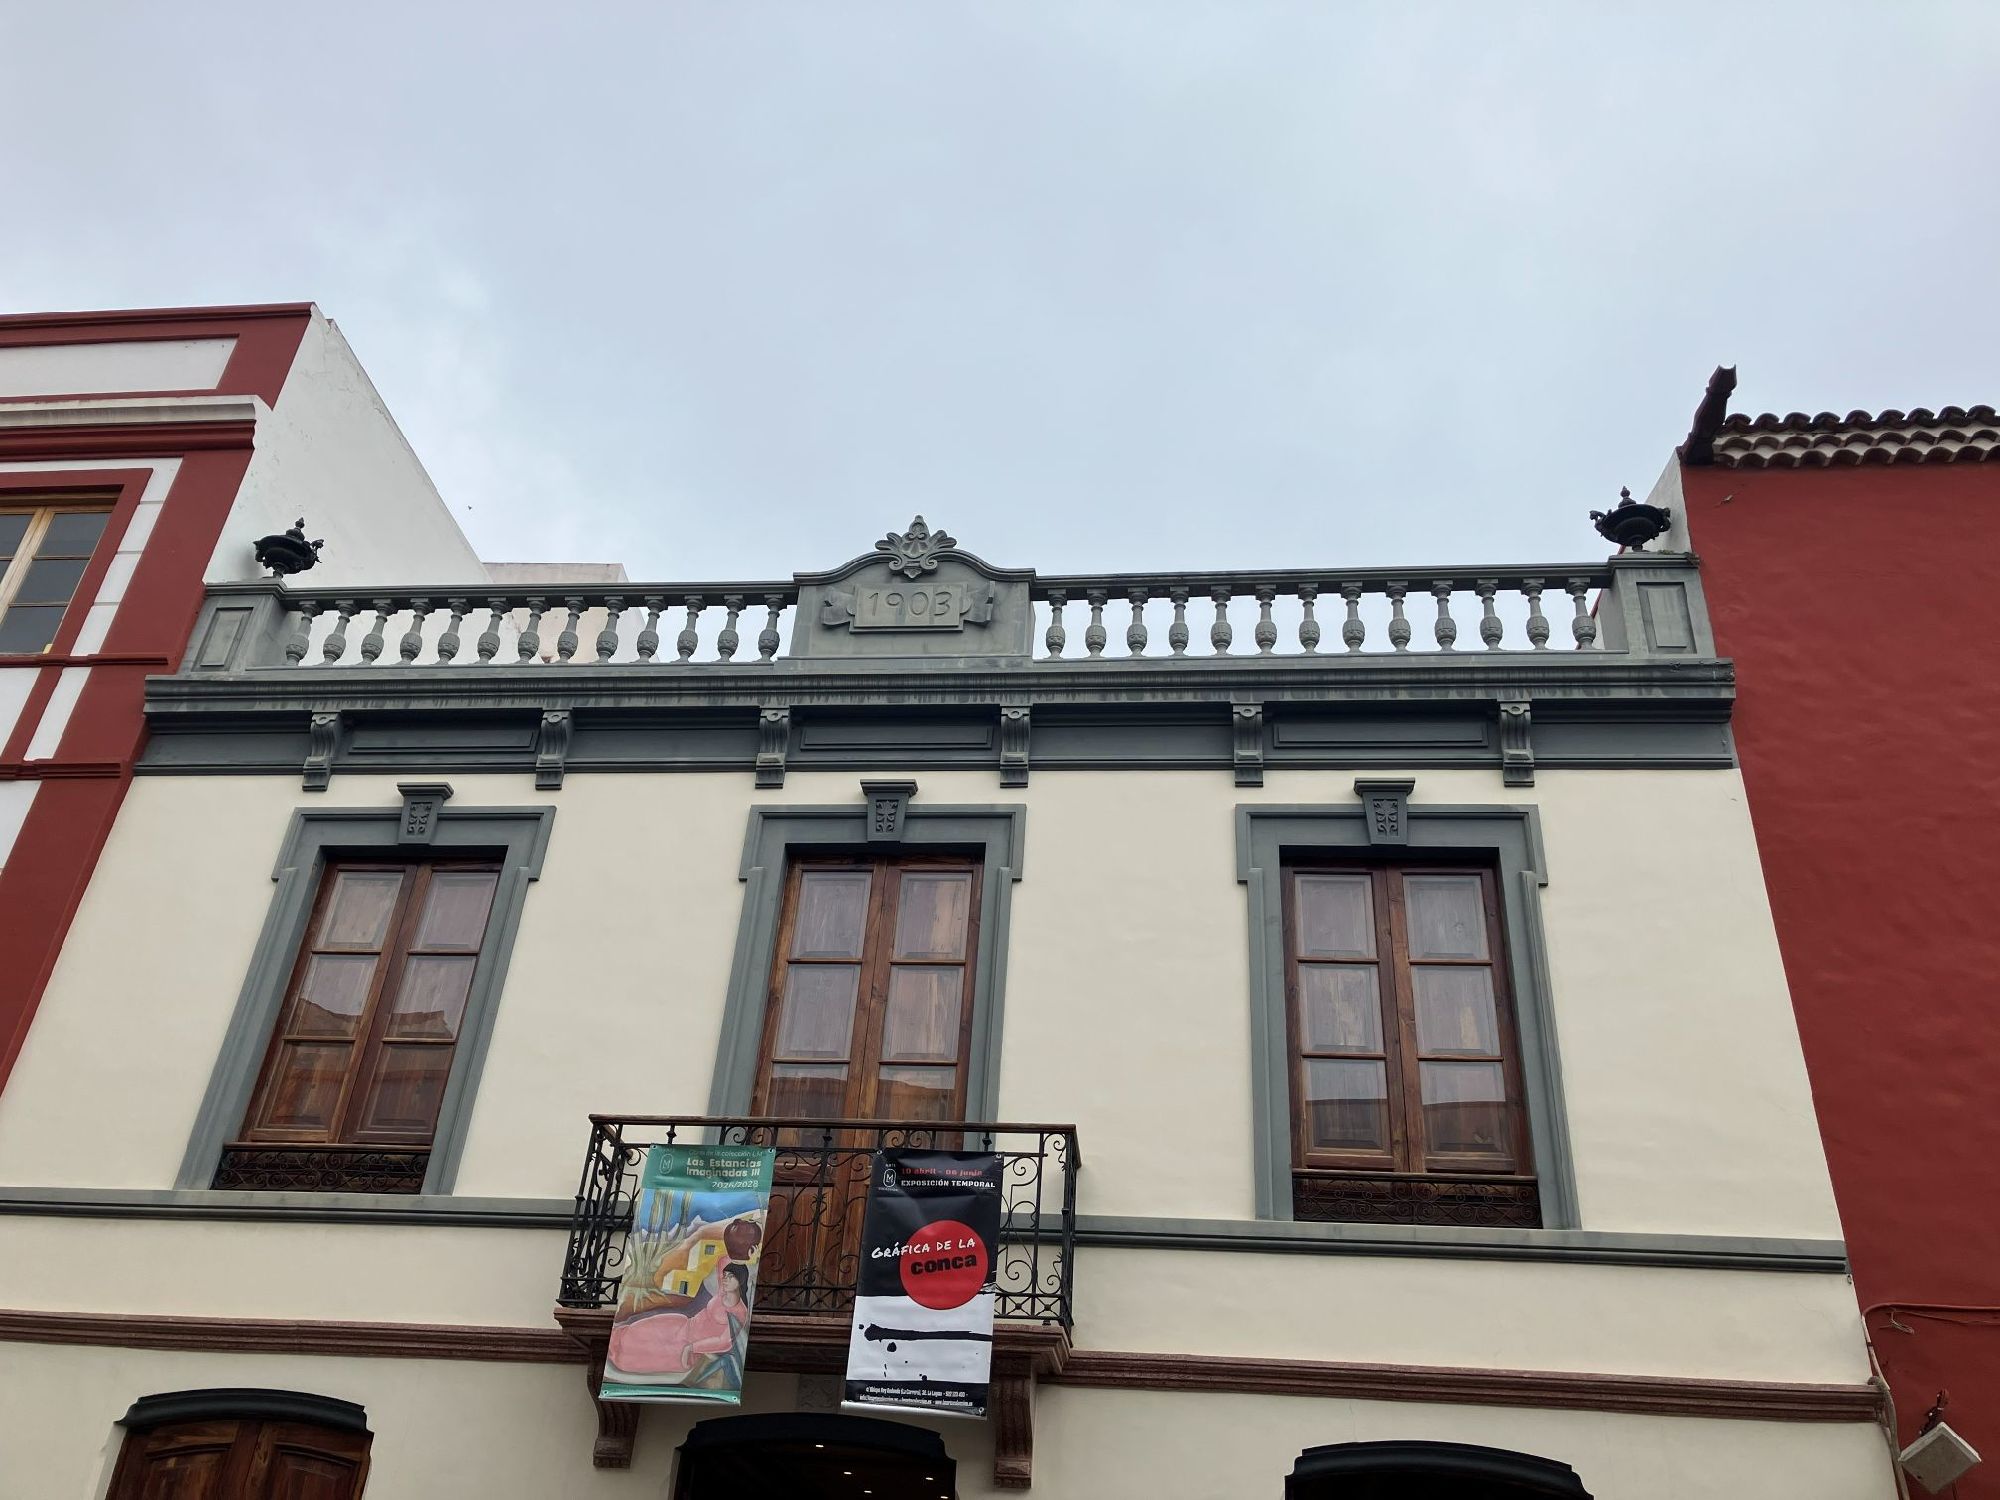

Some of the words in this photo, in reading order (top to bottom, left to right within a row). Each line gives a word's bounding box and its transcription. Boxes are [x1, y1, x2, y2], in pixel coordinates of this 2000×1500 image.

[866, 591, 954, 617] 1903
[686, 1158, 704, 1167] Las
[709, 1158, 762, 1168] Estancias
[686, 1167, 748, 1178] Imaginadas
[901, 1179, 950, 1187] EXPOSICIÓN
[951, 1180, 996, 1188] TEMPORAL
[871, 1242, 930, 1259] GRÁFICA
[936, 1240, 952, 1251] DE
[958, 1238, 976, 1249] LA
[910, 1254, 977, 1275] conca
